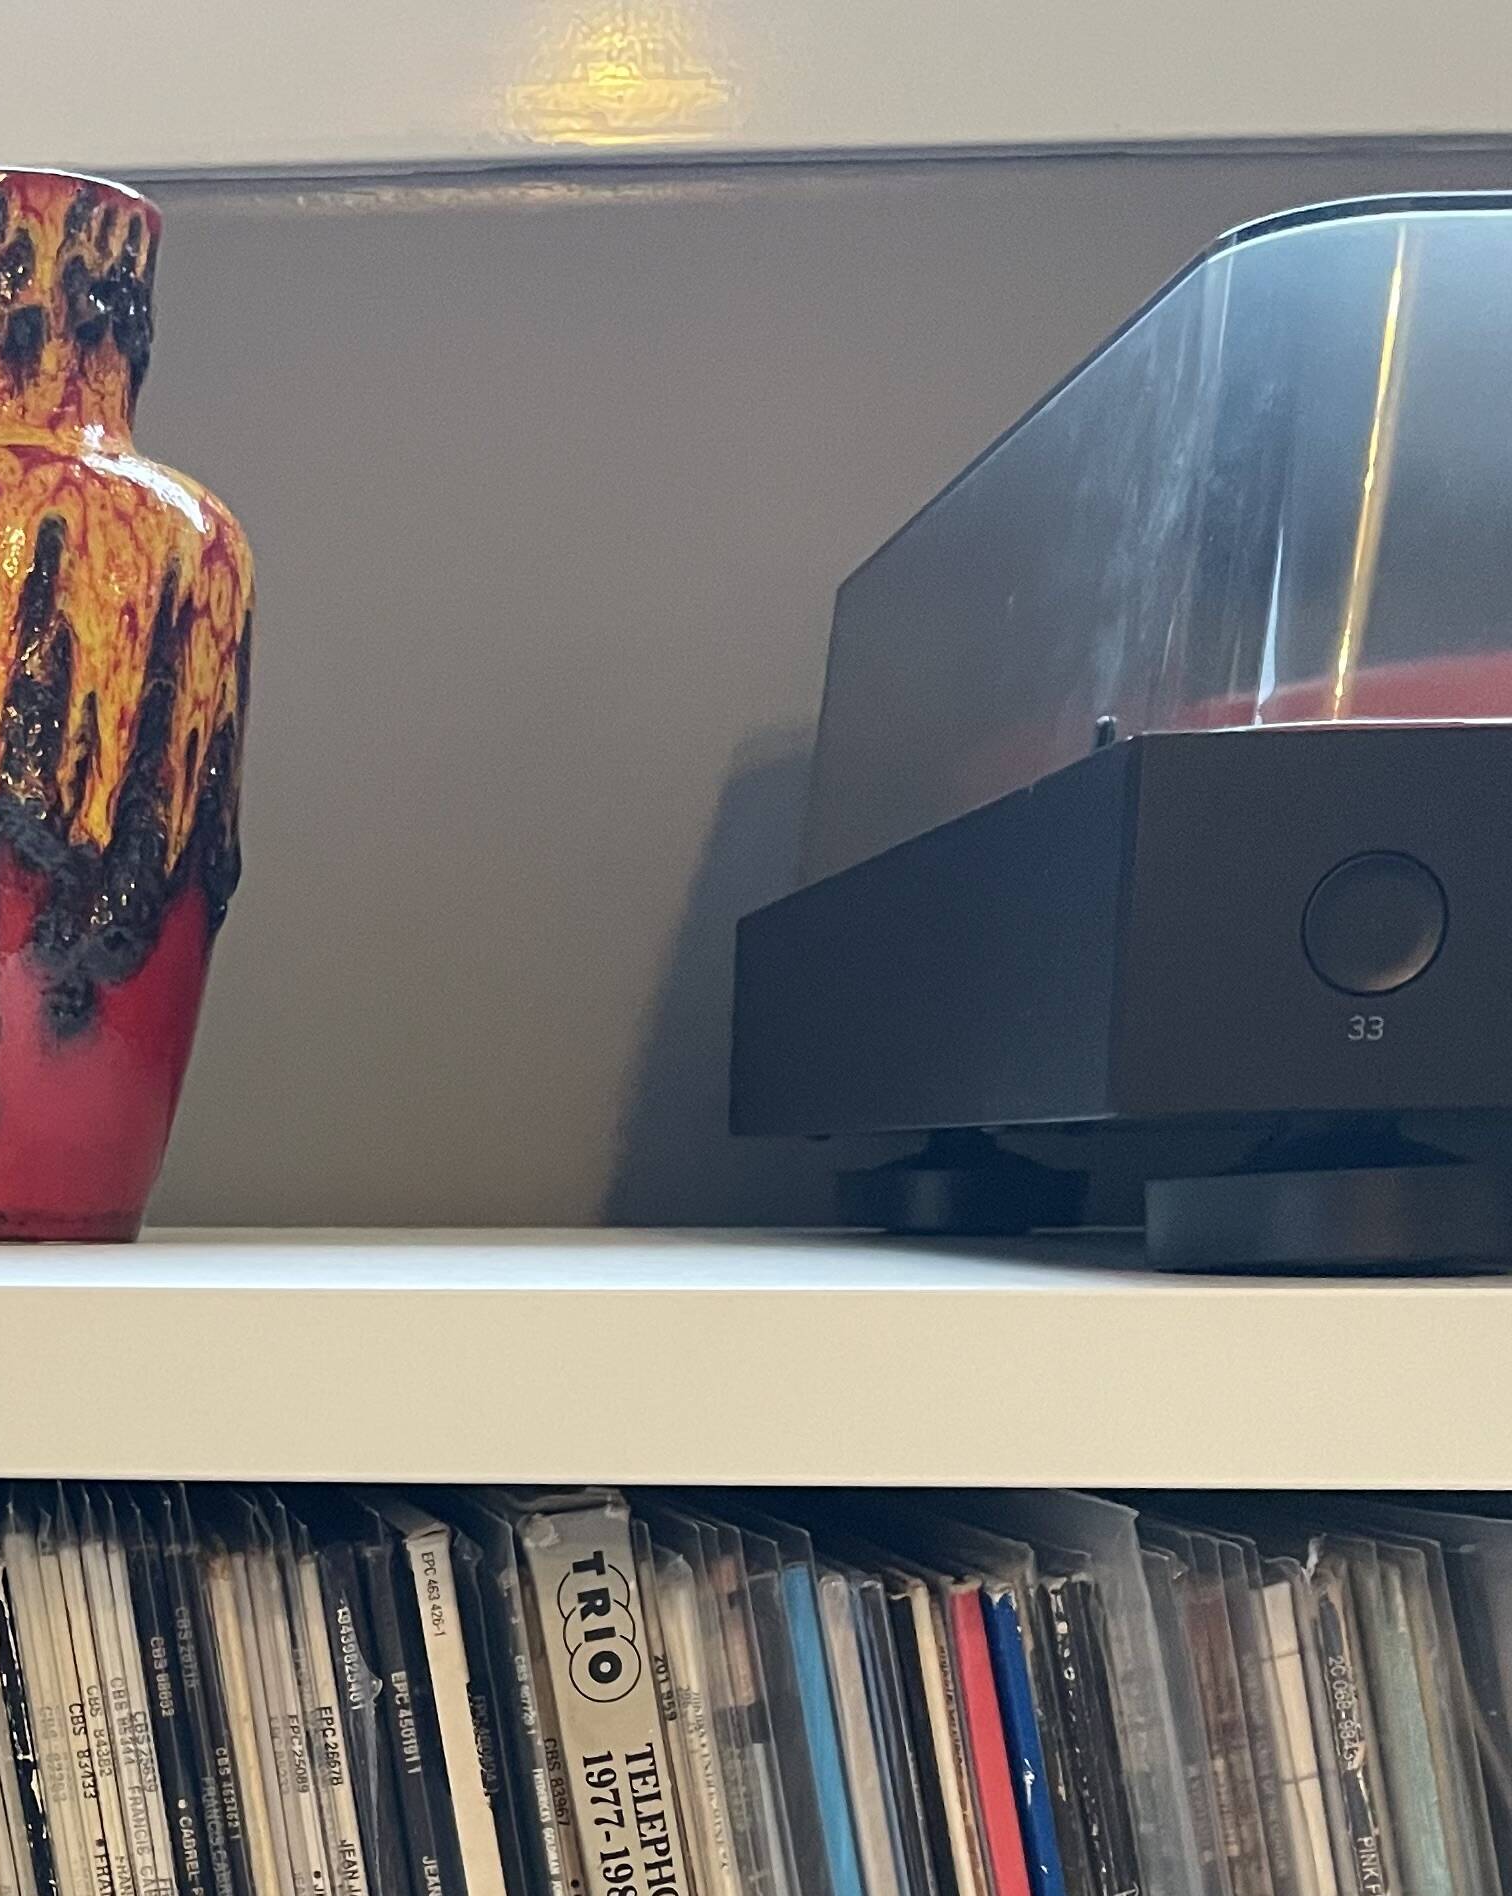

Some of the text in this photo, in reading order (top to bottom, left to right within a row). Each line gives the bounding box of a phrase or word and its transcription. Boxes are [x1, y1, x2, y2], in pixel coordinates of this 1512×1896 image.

[1348, 1014, 1384, 1041] 33
[420, 1551, 446, 1637] EPC 463 426-1
[568, 1550, 625, 1685] TRIO
[85, 1684, 101, 1717] CBS
[390, 1670, 410, 1705] EPC
[659, 1689, 678, 1722] 959
[67, 1702, 86, 1736] CBS
[543, 1737, 562, 1773] CBS
[317, 1706, 335, 1738] EPC
[339, 1838, 358, 1880] JEAN
[549, 1776, 571, 1827] 83967
[126, 1784, 150, 1856] FRANCIS
[178, 1816, 201, 1880] CABREL
[542, 1827, 561, 1874] GOLDMAN
[1356, 1835, 1379, 1880] PINK
